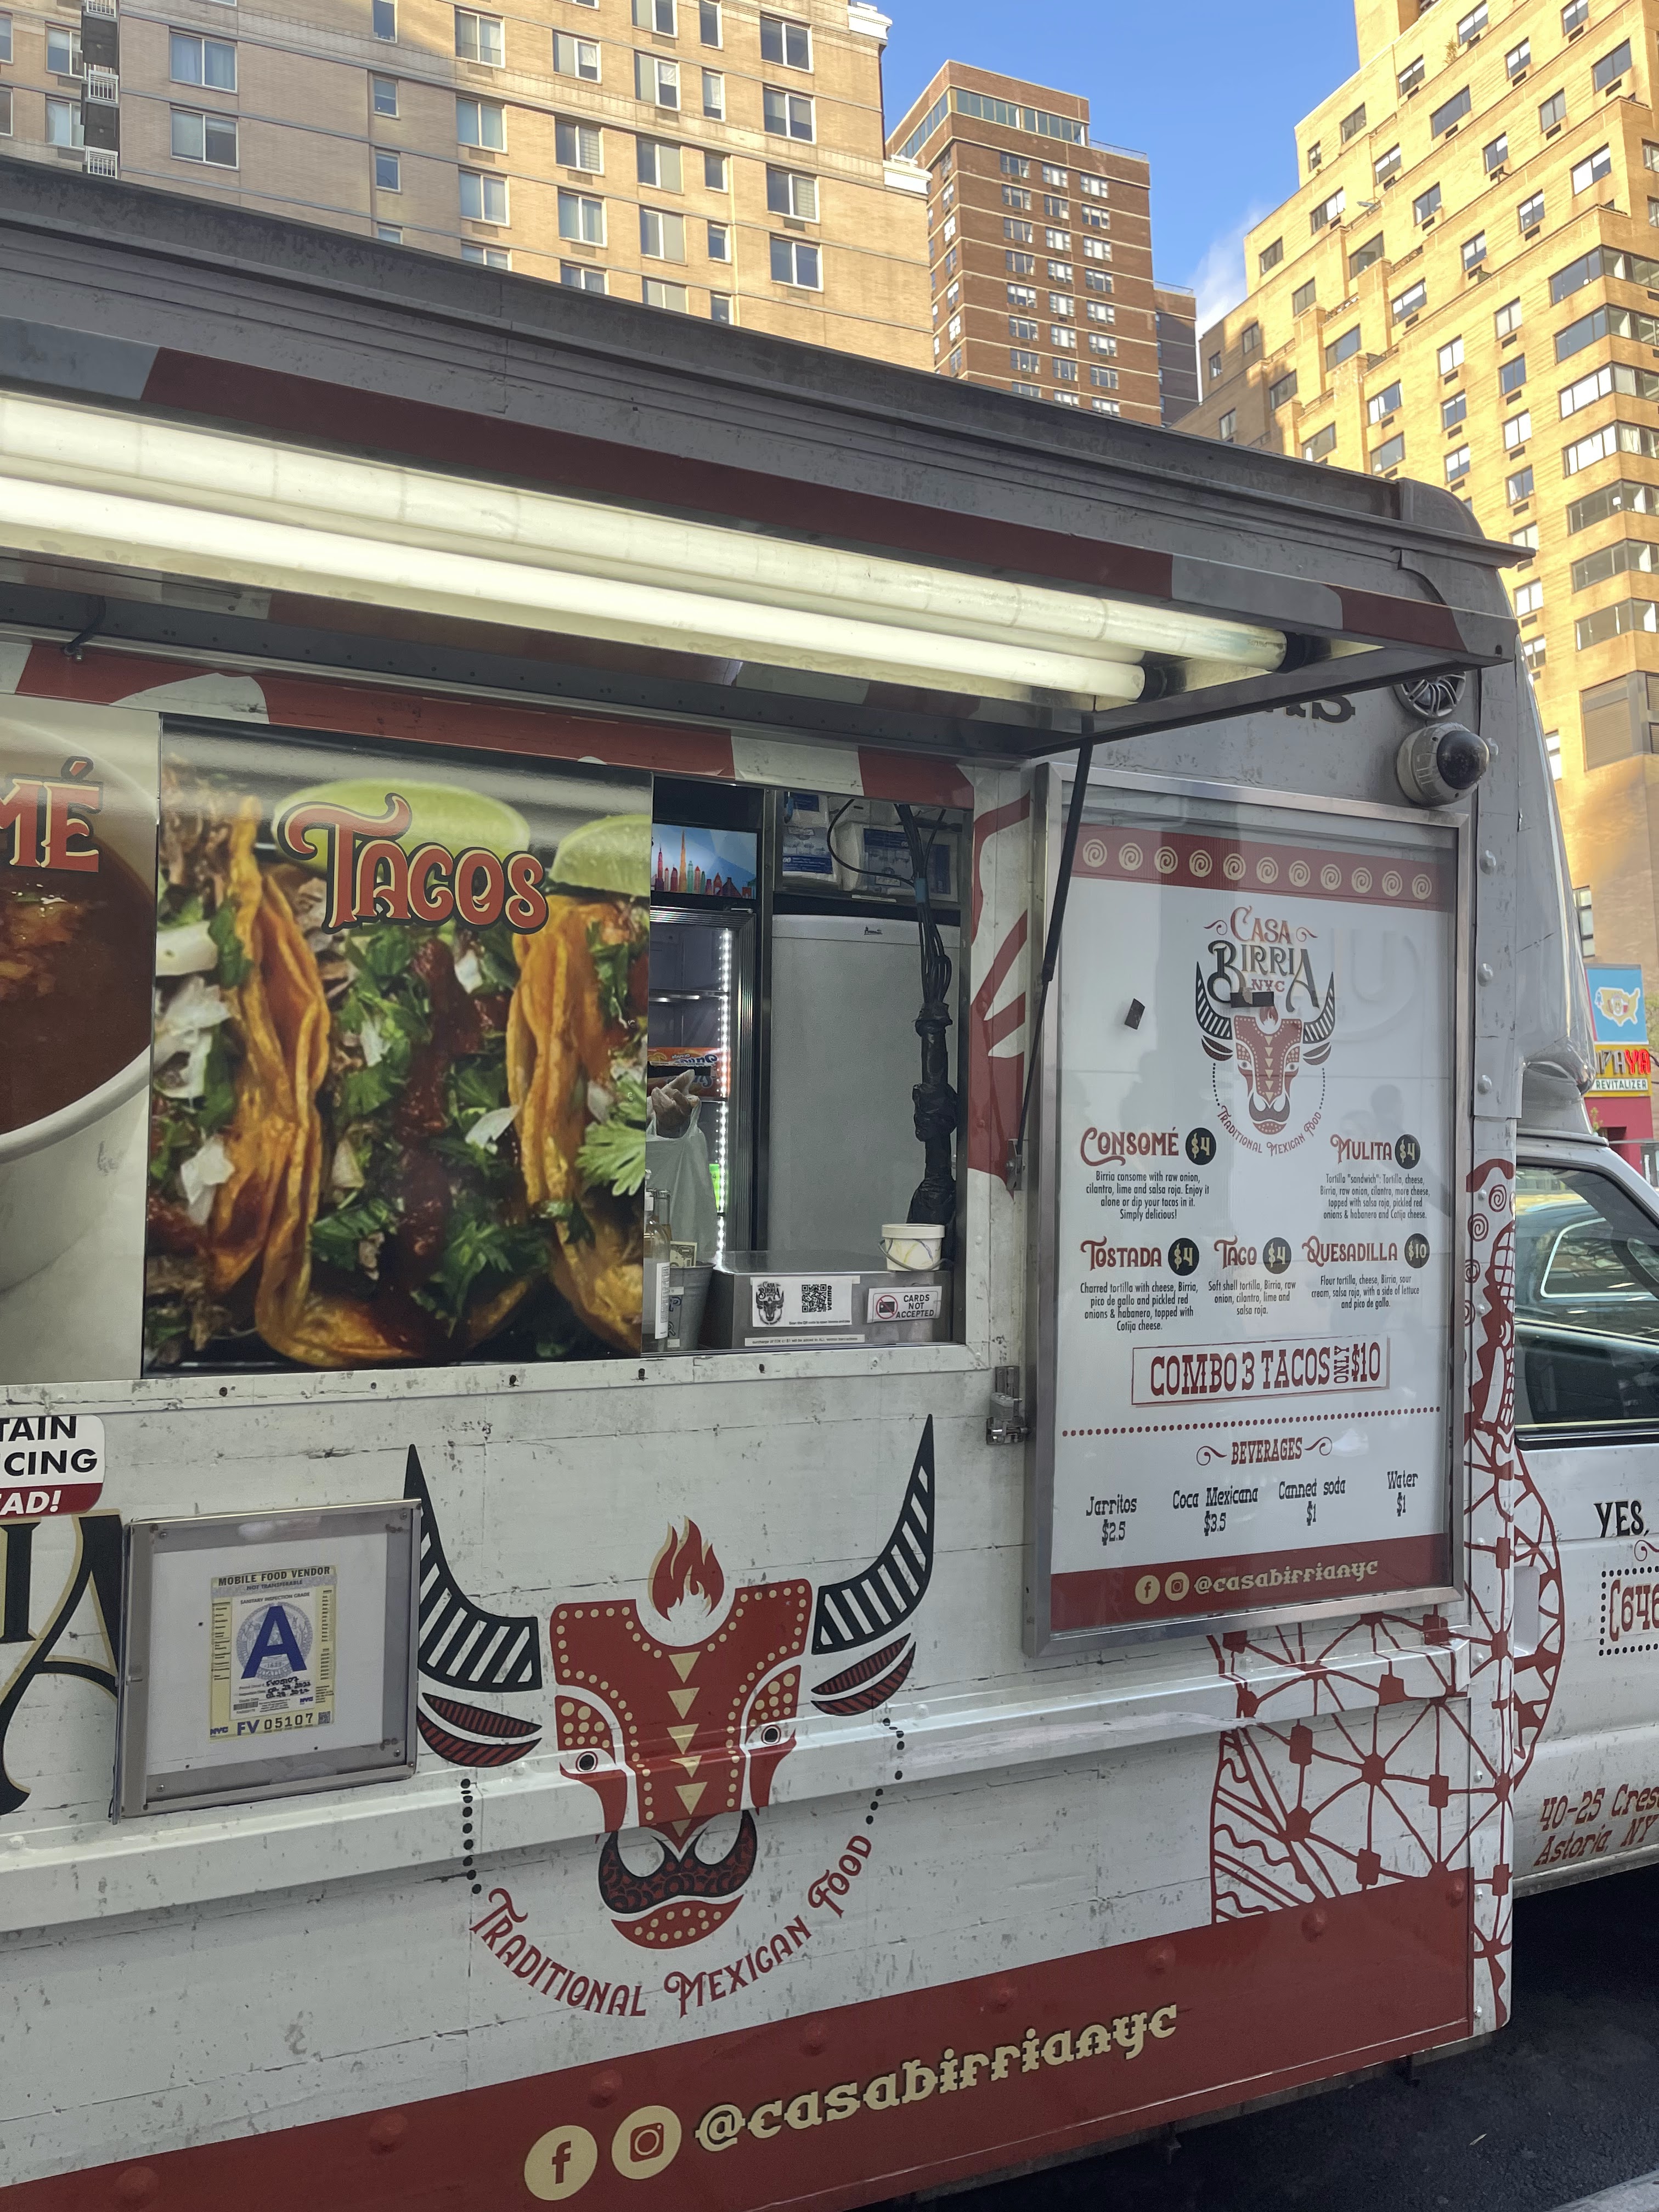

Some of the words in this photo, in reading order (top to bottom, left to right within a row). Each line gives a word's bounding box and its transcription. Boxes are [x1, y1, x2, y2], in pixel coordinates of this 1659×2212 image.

[278, 792, 550, 935] TACOS
[1231, 905, 1293, 944] CASA
[1207, 940, 1320, 1013] BIRRIA
[1250, 979, 1285, 992] NYC
[1596, 1079, 1647, 1090] REVITALIZER
[1217, 1105, 1262, 1153] TRADITIONAL
[1267, 1133, 1306, 1156] MEXICAN
[1304, 1112, 1321, 1137] FOOD
[1080, 1127, 1179, 1167] CONSOMÉ
[1192, 1133, 1211, 1159] $4
[1330, 1134, 1392, 1164] MULITA
[1400, 1139, 1415, 1163] $4
[1096, 1171, 1114, 1181] Birria
[1118, 1173, 1147, 1182] consome
[1149, 1171, 1163, 1181] with
[1180, 1172, 1200, 1183] onion,
[1326, 1173, 1346, 1183] Tortilla
[1383, 1173, 1403, 1186] Tortilla,
[1405, 1173, 1425, 1186] cheese,
[1086, 1183, 1114, 1195] cilantro,
[1117, 1183, 1131, 1194] lime
[1134, 1183, 1147, 1194] and
[1149, 1183, 1165, 1194] salsa
[1168, 1184, 1183, 1197] roja.
[1186, 1184, 1203, 1197] Enjoy
[1320, 1186, 1338, 1197] Birria,
[1352, 1186, 1369, 1197] onion,
[1371, 1184, 1393, 1197] cilantro,
[1411, 1186, 1430, 1197] cheese,
[1101, 1195, 1120, 1206] alone
[1132, 1196, 1142, 1210] dip
[1144, 1199, 1159, 1209] your
[1162, 1198, 1178, 1206] tacos
[1328, 1197, 1348, 1209] topped
[1350, 1197, 1361, 1207] with
[1363, 1197, 1377, 1207] salsa
[1379, 1198, 1391, 1209] roja,
[1393, 1197, 1412, 1209] pickled
[1414, 1197, 1423, 1207] red
[1120, 1209, 1143, 1221] Simply
[1146, 1208, 1177, 1219] delicious!
[1323, 1210, 1342, 1219] onions
[1350, 1209, 1377, 1219] habanero
[1379, 1209, 1389, 1219] and
[1391, 1209, 1406, 1221] Cotija
[1408, 1209, 1427, 1219] cheese.
[1080, 1235, 1162, 1272] TOSTADA
[1174, 1242, 1193, 1270] $4
[1214, 1235, 1257, 1269] TACO
[1268, 1242, 1286, 1269] $4
[1302, 1235, 1397, 1267] QUESADILLA
[1409, 1242, 1427, 1262] $10
[1080, 1282, 1108, 1293] Charred
[1110, 1281, 1133, 1293] tortilla
[1135, 1281, 1149, 1293] with
[1152, 1281, 1176, 1294] cheese,
[1178, 1281, 1198, 1294] Birria,
[1209, 1280, 1221, 1291] Soft
[1223, 1279, 1238, 1290] shell
[1240, 1279, 1262, 1292] tortilla,
[1264, 1279, 1283, 1291] Birria,
[1311, 1290, 1330, 1299] cream,
[1333, 1286, 1346, 1297] salsa
[1348, 1287, 1361, 1299] roja,
[1363, 1285, 1375, 1296] with
[1382, 1285, 1393, 1295] side
[1395, 1284, 1400, 1295] of
[1402, 1284, 1419, 1295] lettuce
[1321, 1274, 1335, 1285] Flour
[1337, 1274, 1357, 1286] tortilla,
[1359, 1274, 1379, 1285] cheese,
[1381, 1274, 1398, 1285] Birria,
[904, 1294, 930, 1302] CARDS
[1091, 1296, 1104, 1308] pico
[1107, 1294, 1115, 1306] de
[1118, 1294, 1135, 1308] gallo
[1137, 1294, 1150, 1305] and
[1152, 1293, 1176, 1307] pickled
[1177, 1293, 1188, 1305] red
[1215, 1294, 1234, 1305] onion,
[1236, 1291, 1261, 1304] cilantro,
[1263, 1291, 1277, 1302] lime
[1278, 1290, 1290, 1301] and
[1341, 1298, 1352, 1308] and
[1353, 1299, 1365, 1311] pico
[1367, 1297, 1374, 1308] de
[1375, 1297, 1391, 1310] gallo.
[895, 1310, 934, 1318] ACCEPTED
[1085, 1309, 1108, 1319] onions
[1118, 1307, 1153, 1319] habanero,
[1155, 1306, 1177, 1319] topped
[1180, 1306, 1194, 1317] with
[1237, 1304, 1252, 1315] salsa
[1254, 1305, 1268, 1317] roja.
[1117, 1321, 1136, 1333] Cotija
[1138, 1319, 1163, 1330] cheese.
[1151, 1352, 1237, 1396] COMBO
[1242, 1351, 1255, 1391] 3
[1261, 1347, 1330, 1390] TACOS
[1334, 1345, 1350, 1384] ONLY
[1351, 1342, 1380, 1382] $10
[4, 1448, 98, 1476] CING
[1231, 1437, 1303, 1465] BEVERAGES
[1279, 1479, 1317, 1500] Canned
[1323, 1476, 1346, 1496] soda
[1387, 1471, 1418, 1489] Water
[0, 1490, 62, 1516] AD!
[1086, 1496, 1137, 1516] Jarritos
[1173, 1490, 1198, 1509] Coca
[1206, 1486, 1258, 1508] Mexicana
[1397, 1492, 1406, 1517] $1
[1204, 1510, 1226, 1537] $3.5
[1306, 1500, 1317, 1526] $1
[1593, 1500, 1650, 1538] YES,
[1102, 1519, 1126, 1546] $2.5
[218, 1575, 257, 1586] MOBILE
[261, 1571, 287, 1581] FOOD
[291, 1567, 330, 1578] VENDOR
[262, 1580, 302, 1589] TRANSFERABLE
[1194, 1560, 1378, 1595] @casabirrianyc
[241, 1605, 307, 1679] A
[237, 1719, 260, 1736] FV
[264, 1713, 313, 1730] 05107
[1540, 1787, 1606, 1831] 40-25
[1611, 1784, 1659, 1816] Cres
[1620, 1814, 1659, 1847] NY
[469, 1887, 646, 2017] TRADITIONAL
[664, 1915, 814, 2019] MEXICAN
[808, 1835, 872, 1918] FOOD
[694, 2004, 1178, 2153] @casabirrianyc
